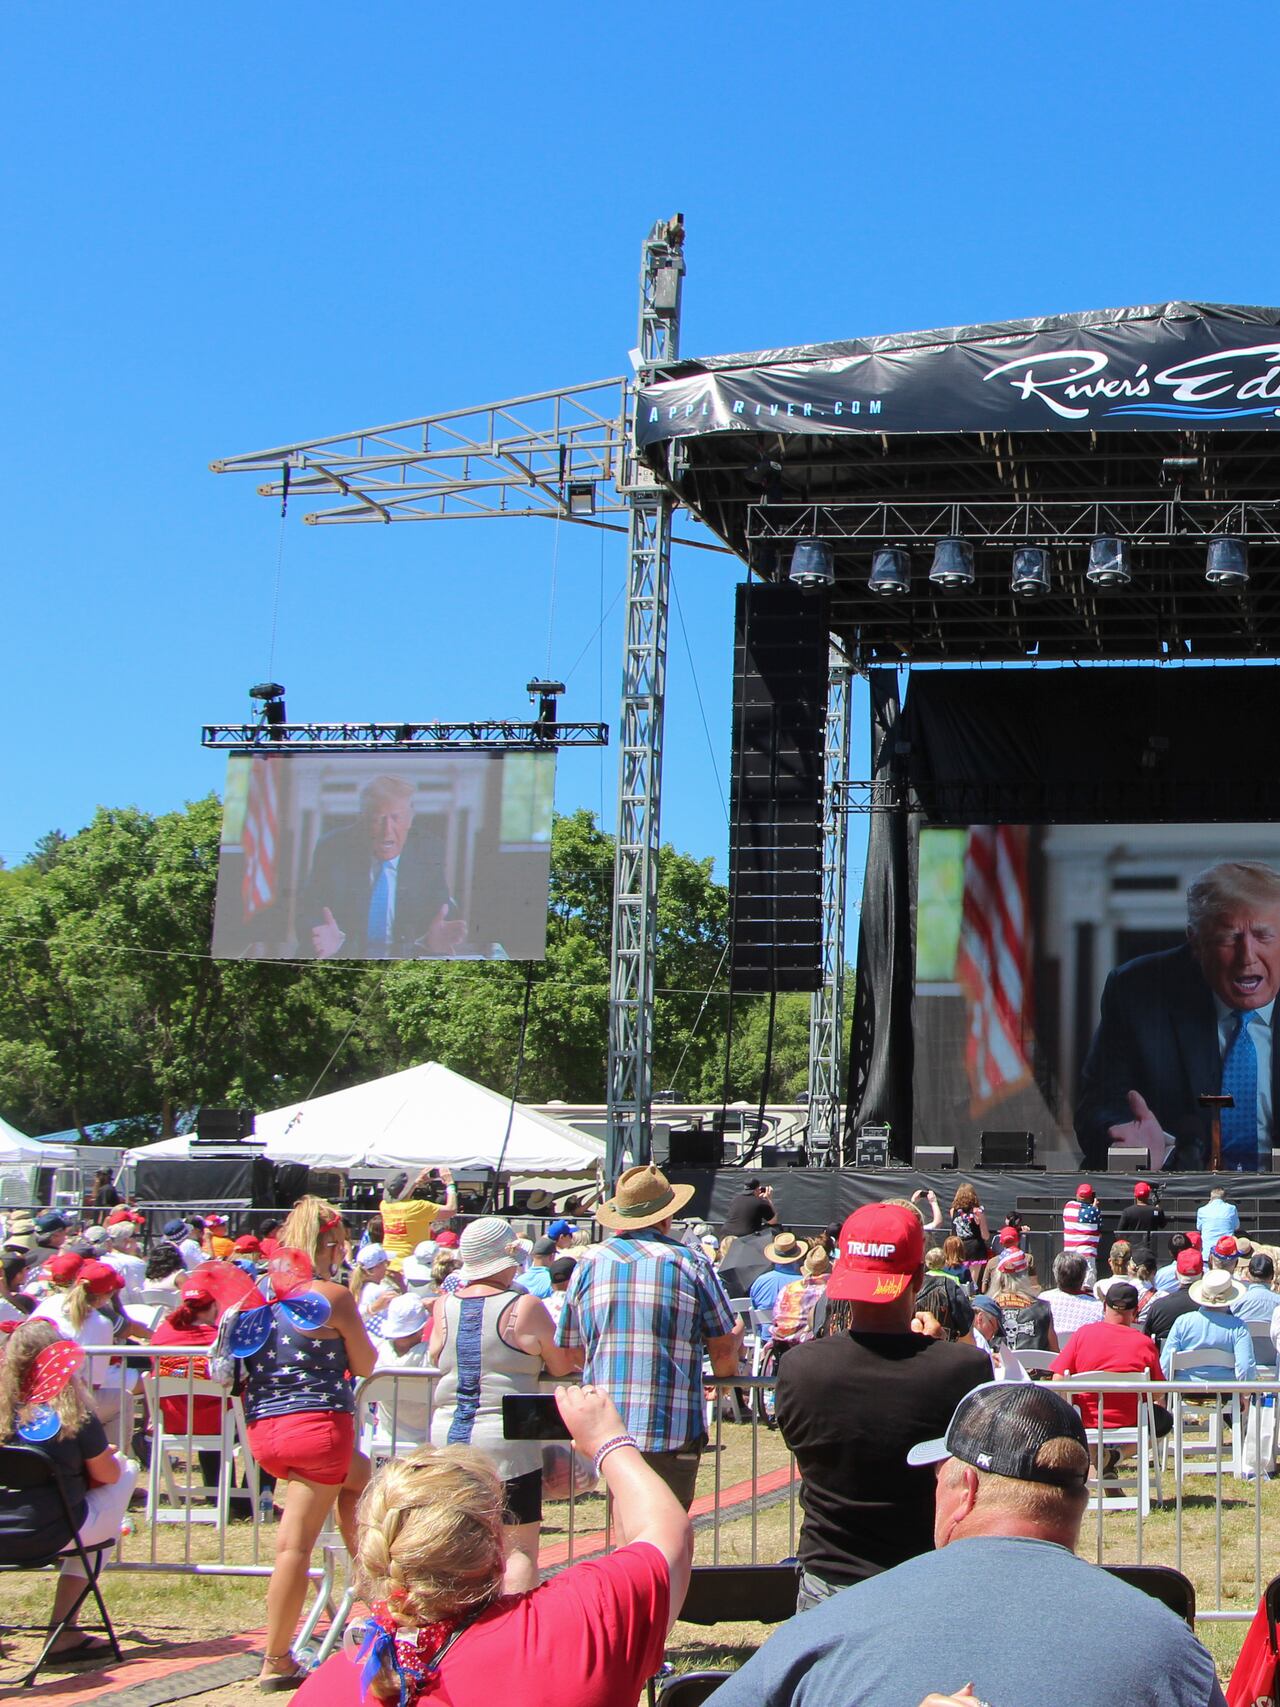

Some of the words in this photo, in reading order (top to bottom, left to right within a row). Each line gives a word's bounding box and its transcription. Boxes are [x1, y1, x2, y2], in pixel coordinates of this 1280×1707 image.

[983, 350, 1150, 419] River's
[648, 399, 882, 423] APPLRIVER.COM
[847, 1241, 896, 1258] TRUMP
[976, 1453, 993, 1467] PK
